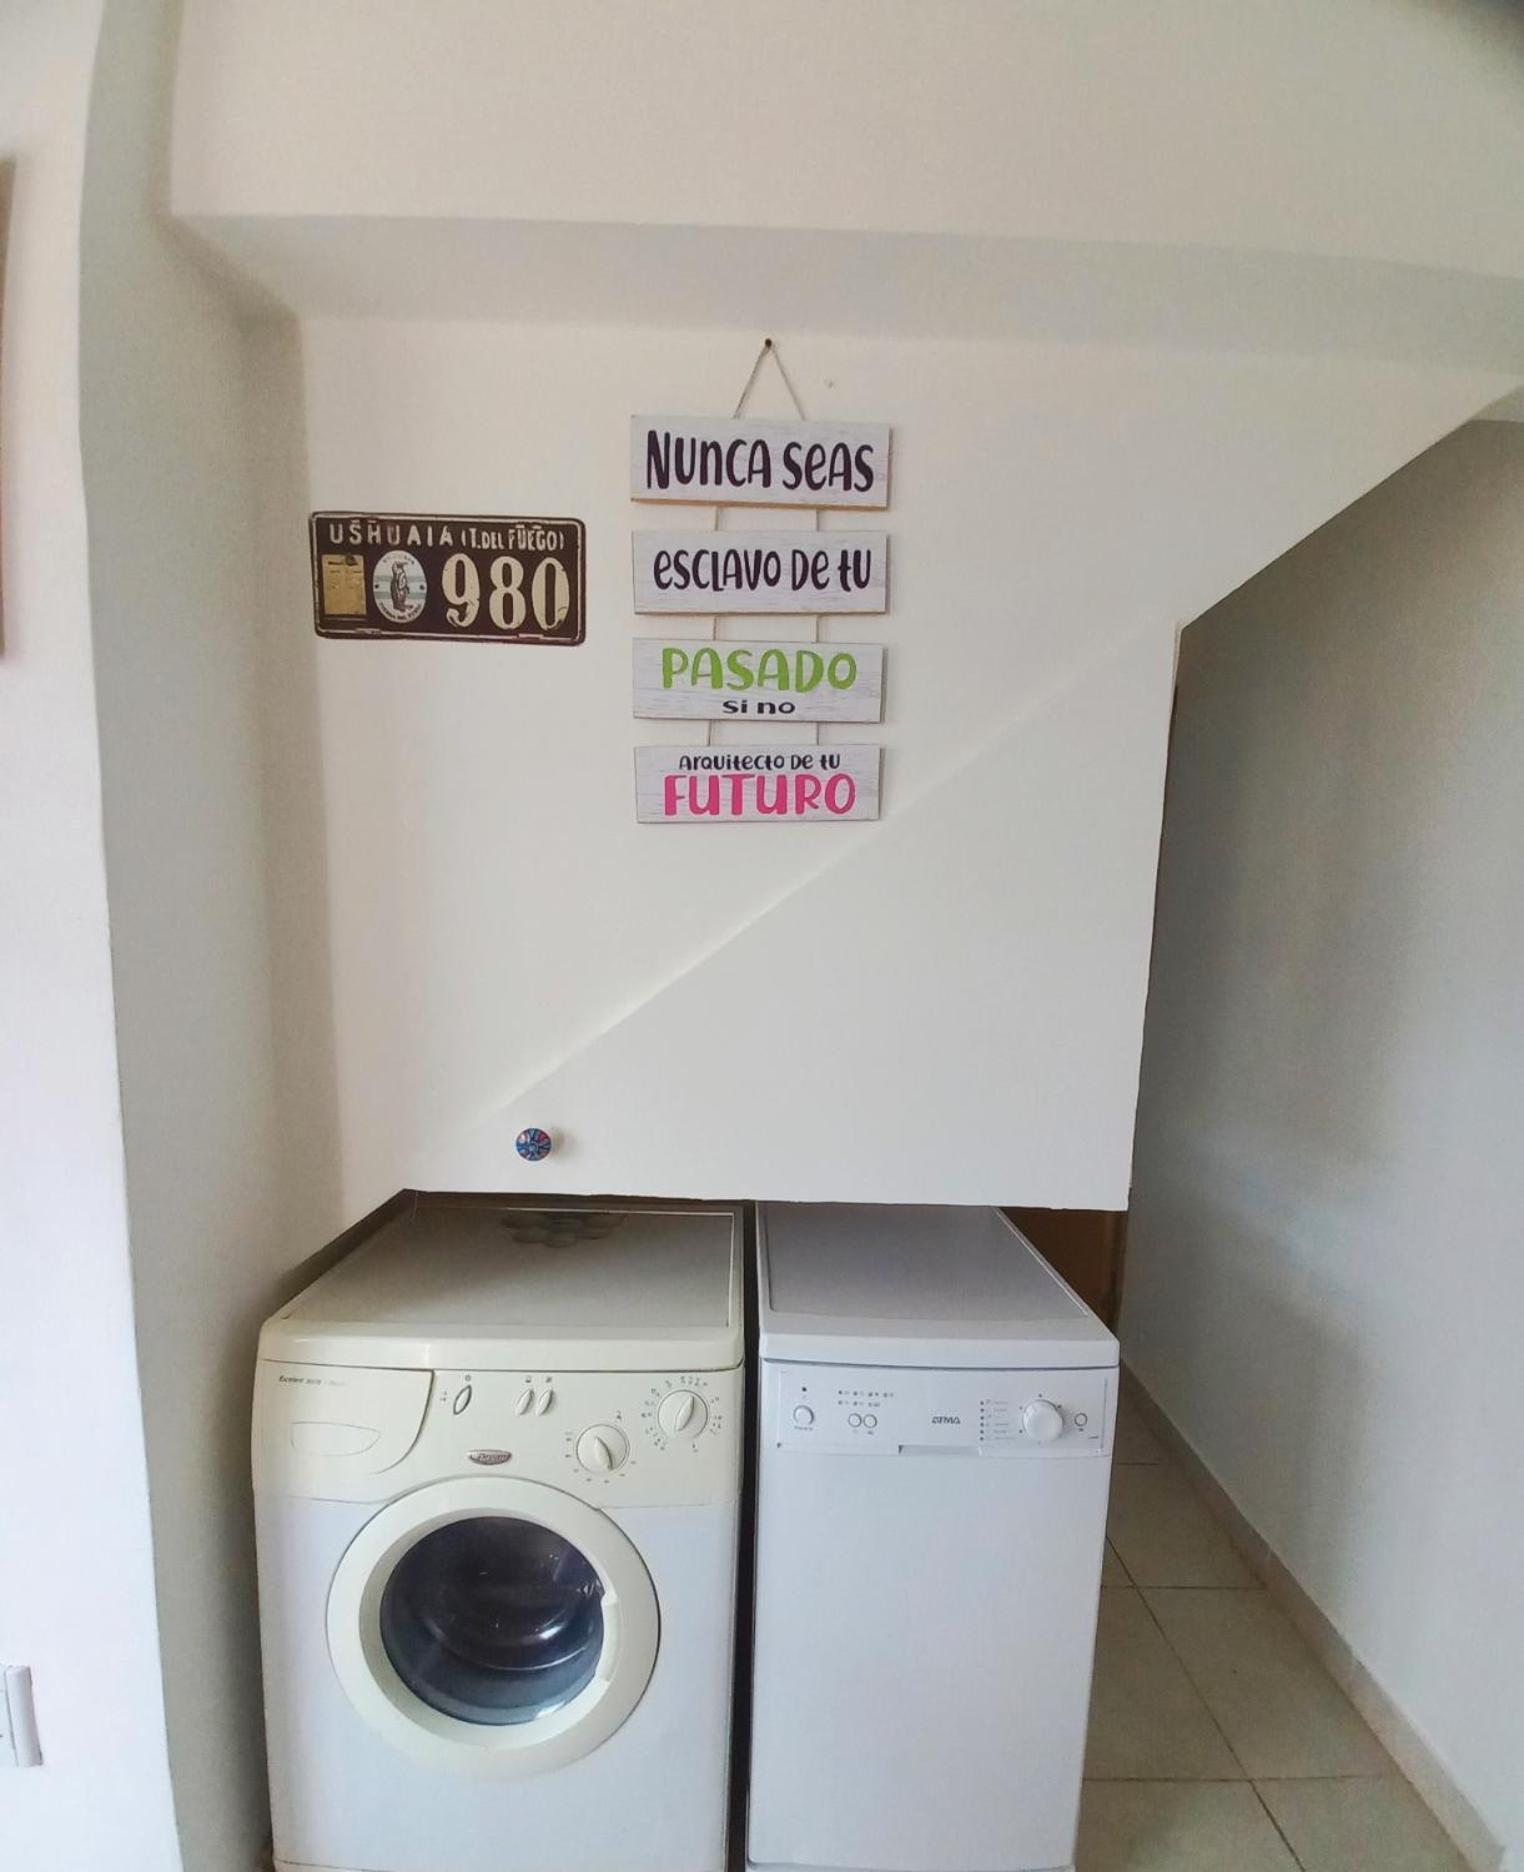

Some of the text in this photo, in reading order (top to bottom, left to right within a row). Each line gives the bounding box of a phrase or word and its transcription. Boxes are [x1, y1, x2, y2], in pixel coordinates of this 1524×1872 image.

[329, 523, 454, 547] USHUAIA
[441, 552, 570, 631] 980
[662, 647, 857, 693] PASADO
[664, 773, 856, 816] FUTURO
